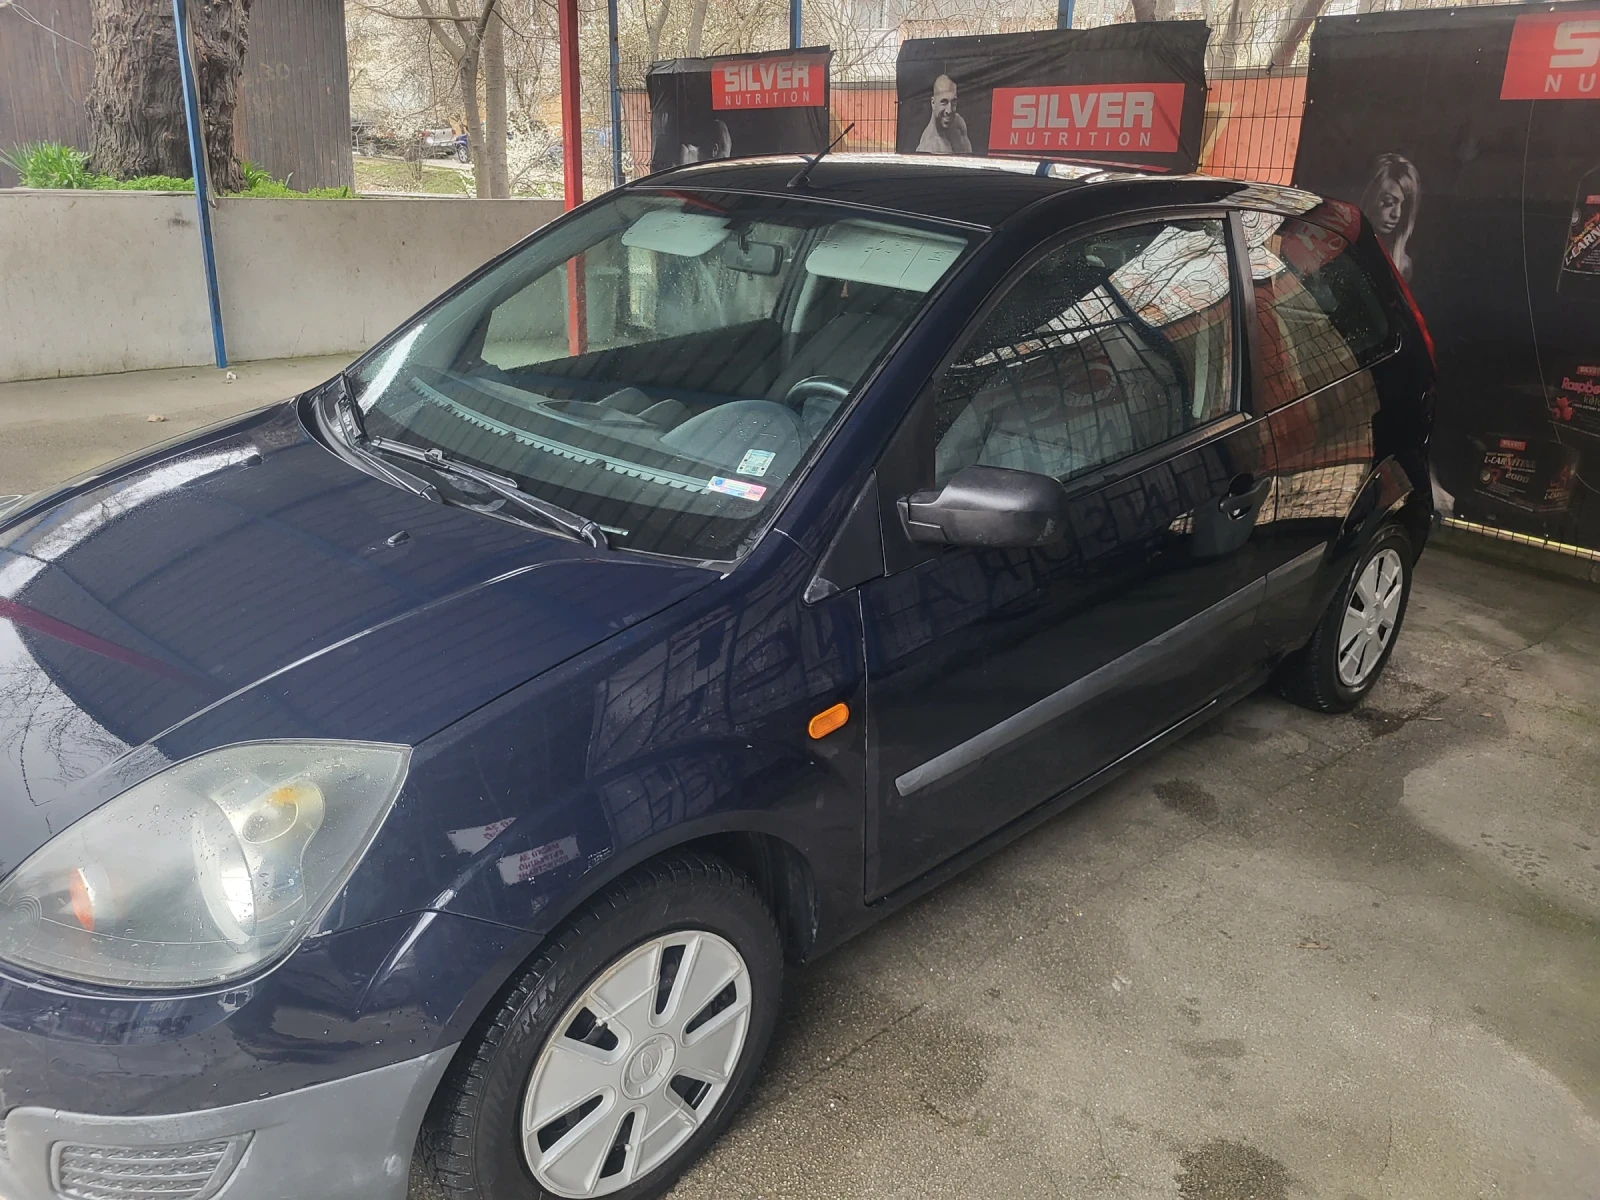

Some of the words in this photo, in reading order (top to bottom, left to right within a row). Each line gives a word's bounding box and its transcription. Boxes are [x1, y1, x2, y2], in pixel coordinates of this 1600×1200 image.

[724, 60, 809, 93] SILVER
[725, 90, 810, 106] NUTRITION
[1012, 92, 1154, 129] SILVER
[1009, 131, 1152, 148] NUTRITION
[1505, 472, 1530, 483] 2000
